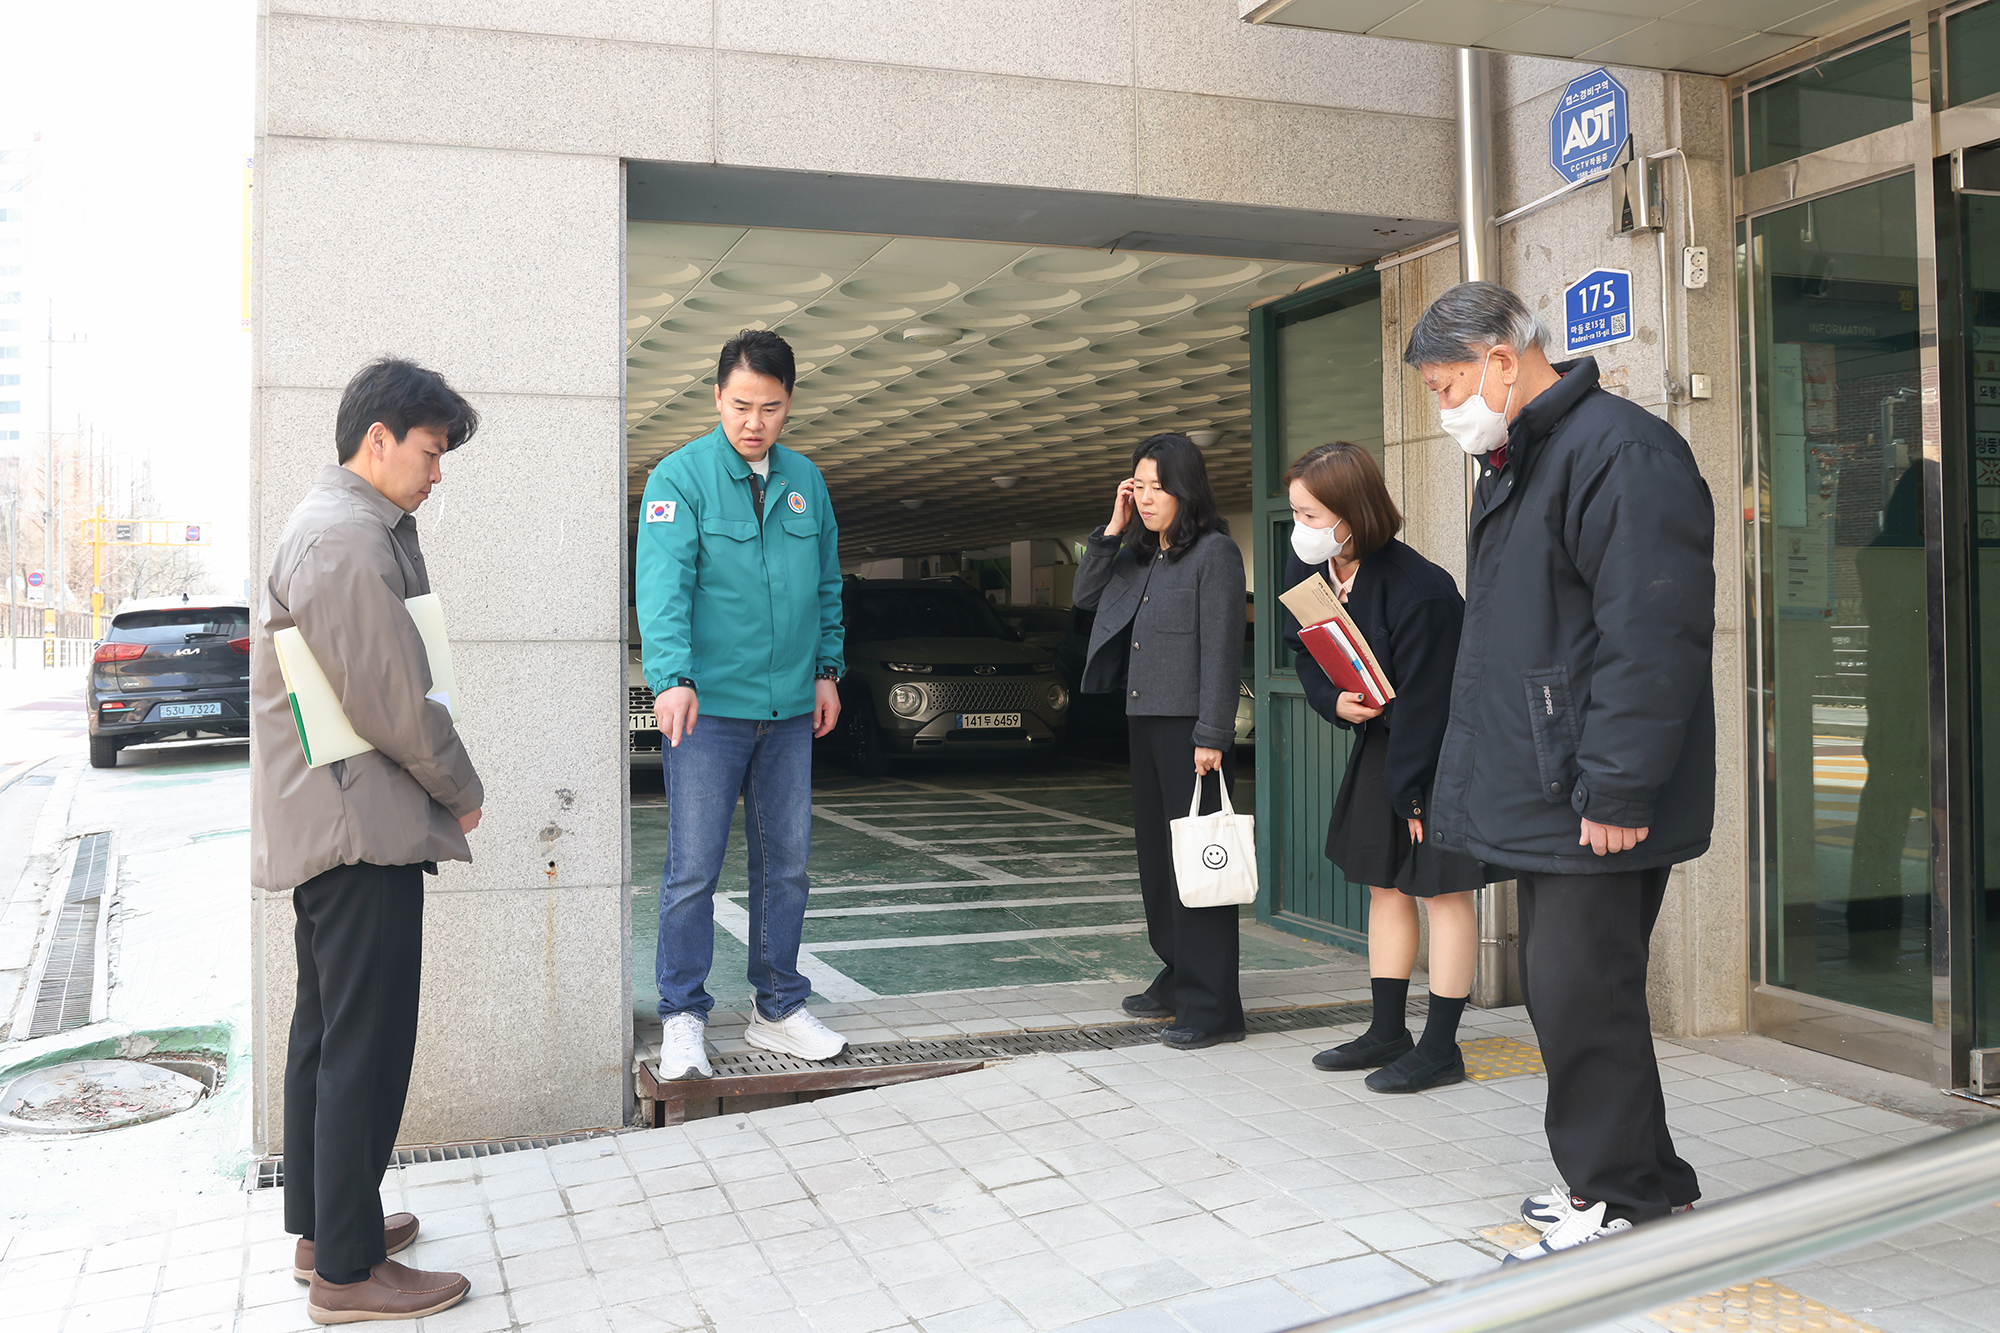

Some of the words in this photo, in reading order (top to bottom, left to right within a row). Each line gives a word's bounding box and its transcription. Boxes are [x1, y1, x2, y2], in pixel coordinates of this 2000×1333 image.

[1565, 79, 1609, 106] 캡스경비구역
[1563, 100, 1615, 156] ADT
[1578, 279, 1616, 315] 175
[1570, 318, 1606, 336] 마들로13길
[1809, 323, 1876, 337] INFORMATION
[1985, 359, 2000, 373] 효
[1979, 385, 2000, 399] 도봉
[1976, 437, 2000, 454] 창동
[189, 704, 216, 715] 7322
[964, 715, 992, 727] 141두
[993, 714, 1019, 727] 6459
